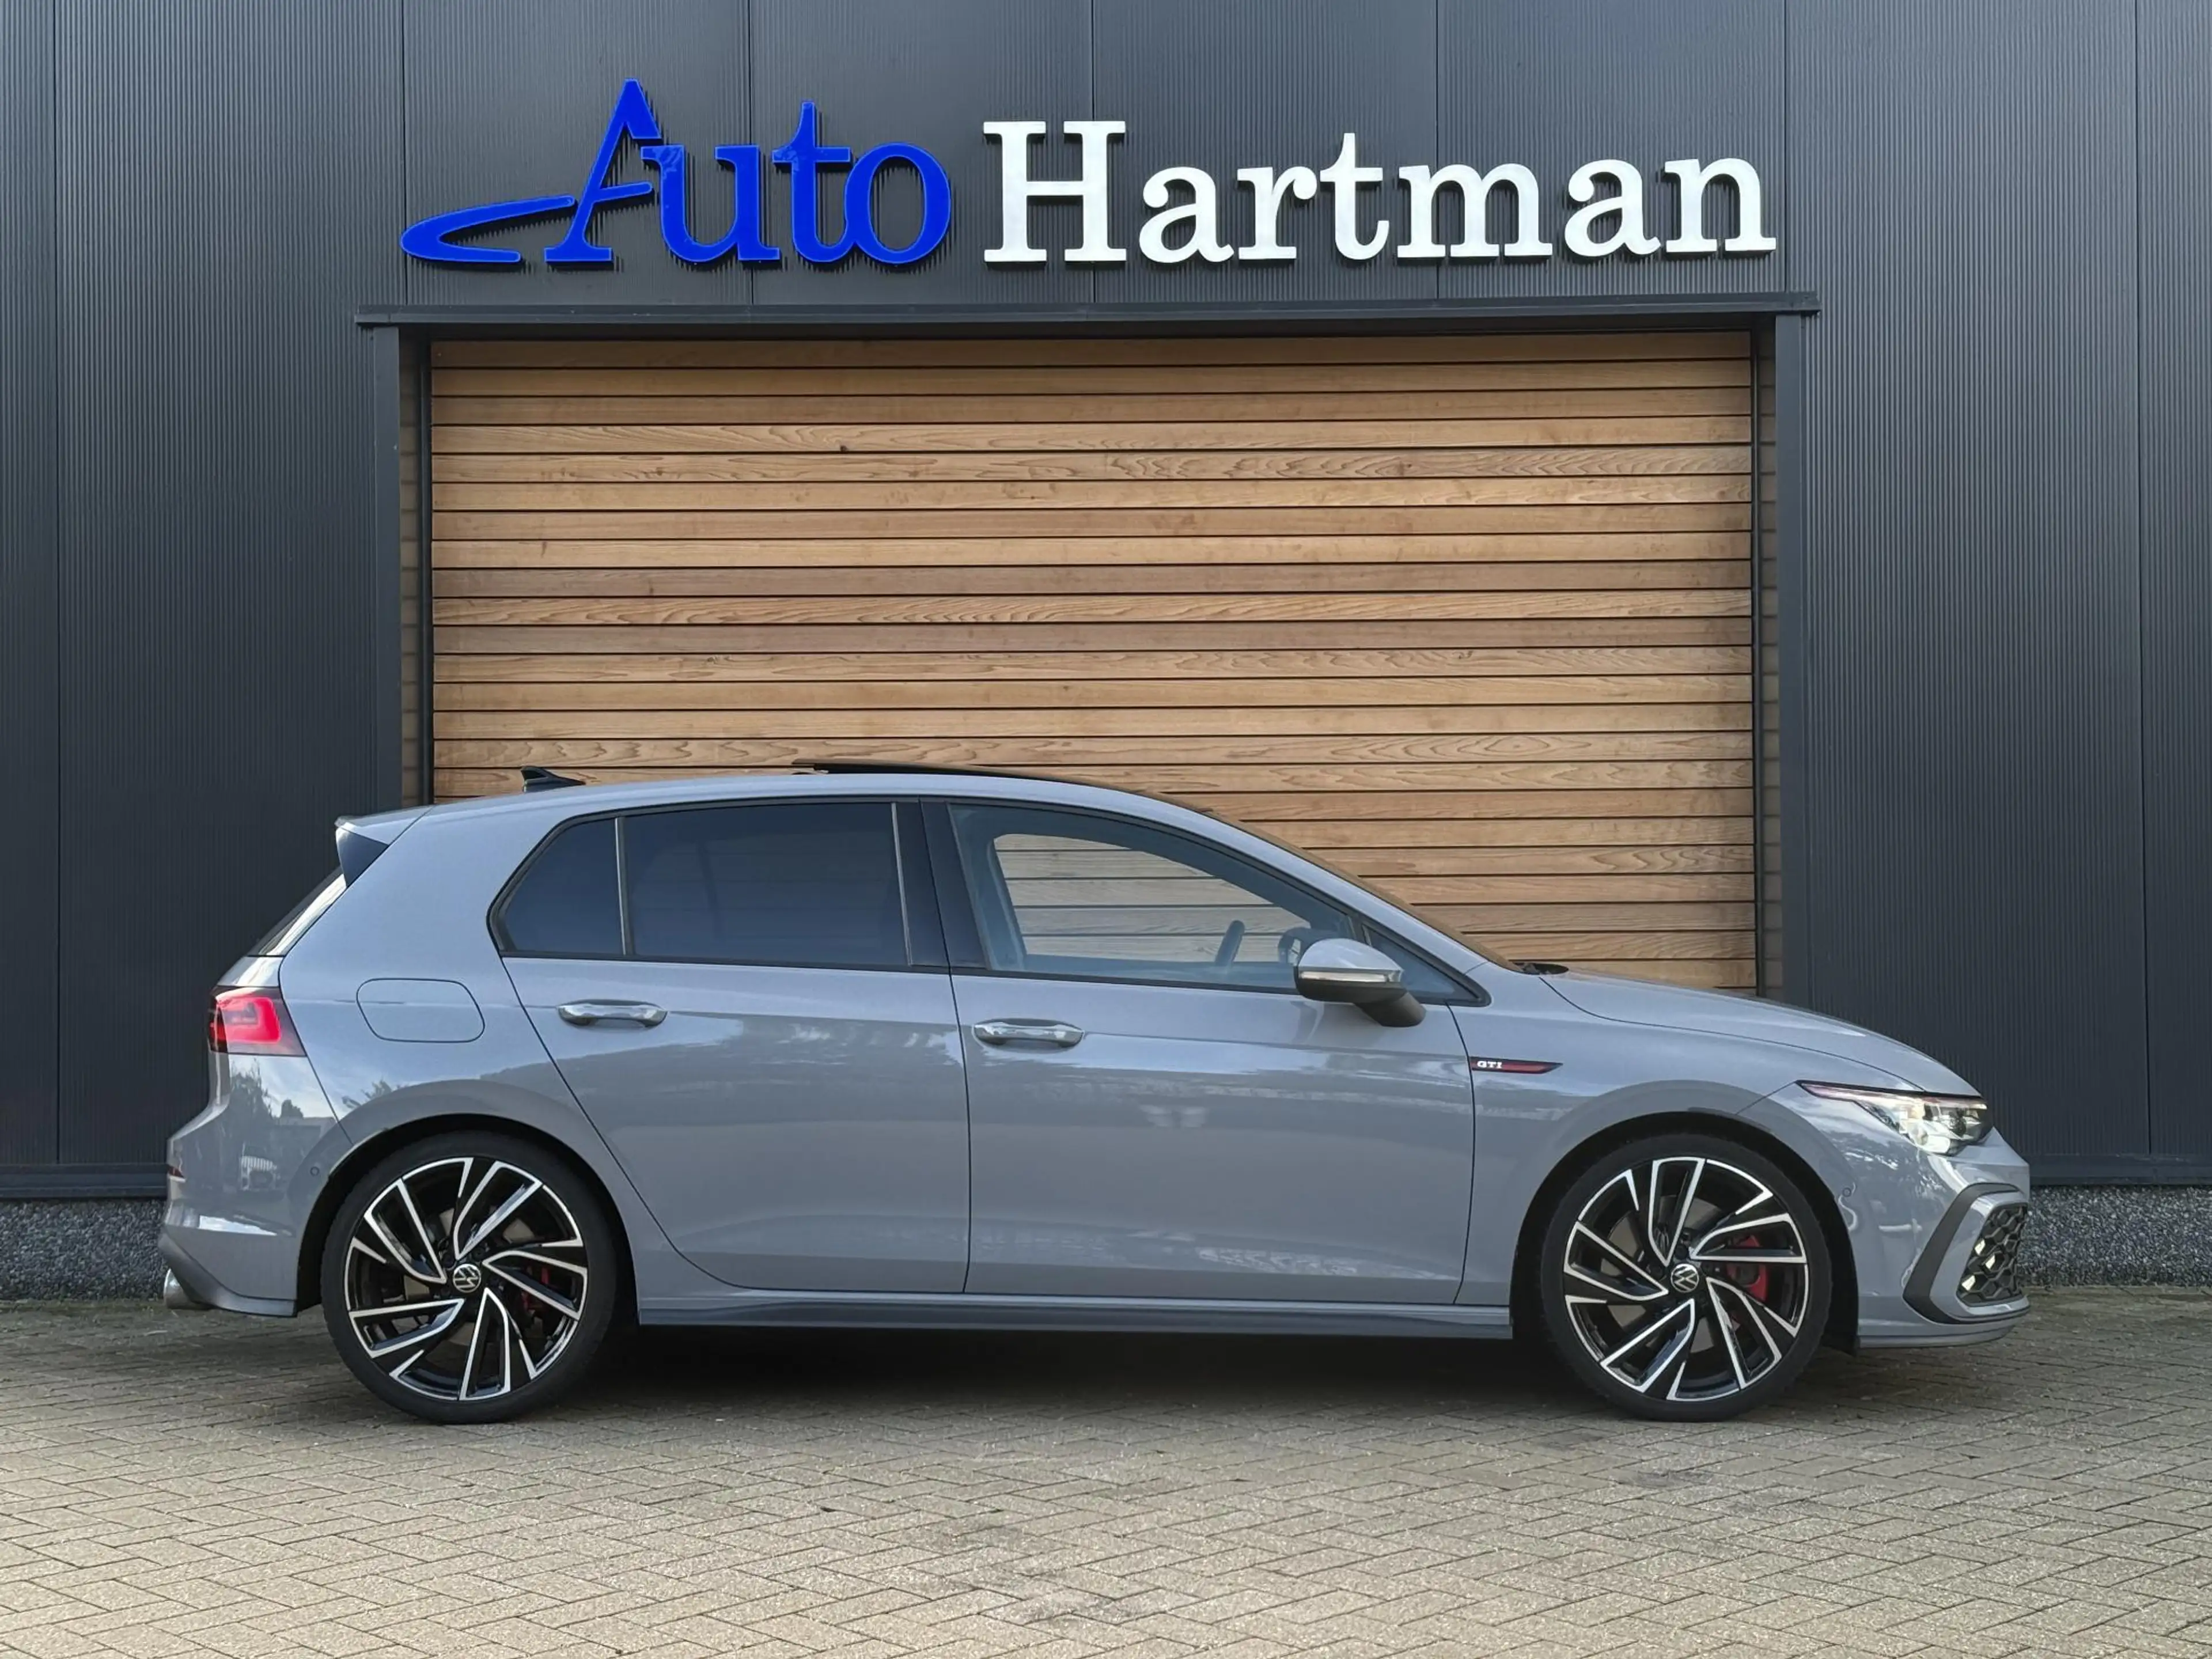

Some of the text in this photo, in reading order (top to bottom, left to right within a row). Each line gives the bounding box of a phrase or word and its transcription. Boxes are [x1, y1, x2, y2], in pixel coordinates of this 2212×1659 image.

[400, 78, 1777, 264] Auto Hartman
[1476, 1060, 1502, 1069] GTI
